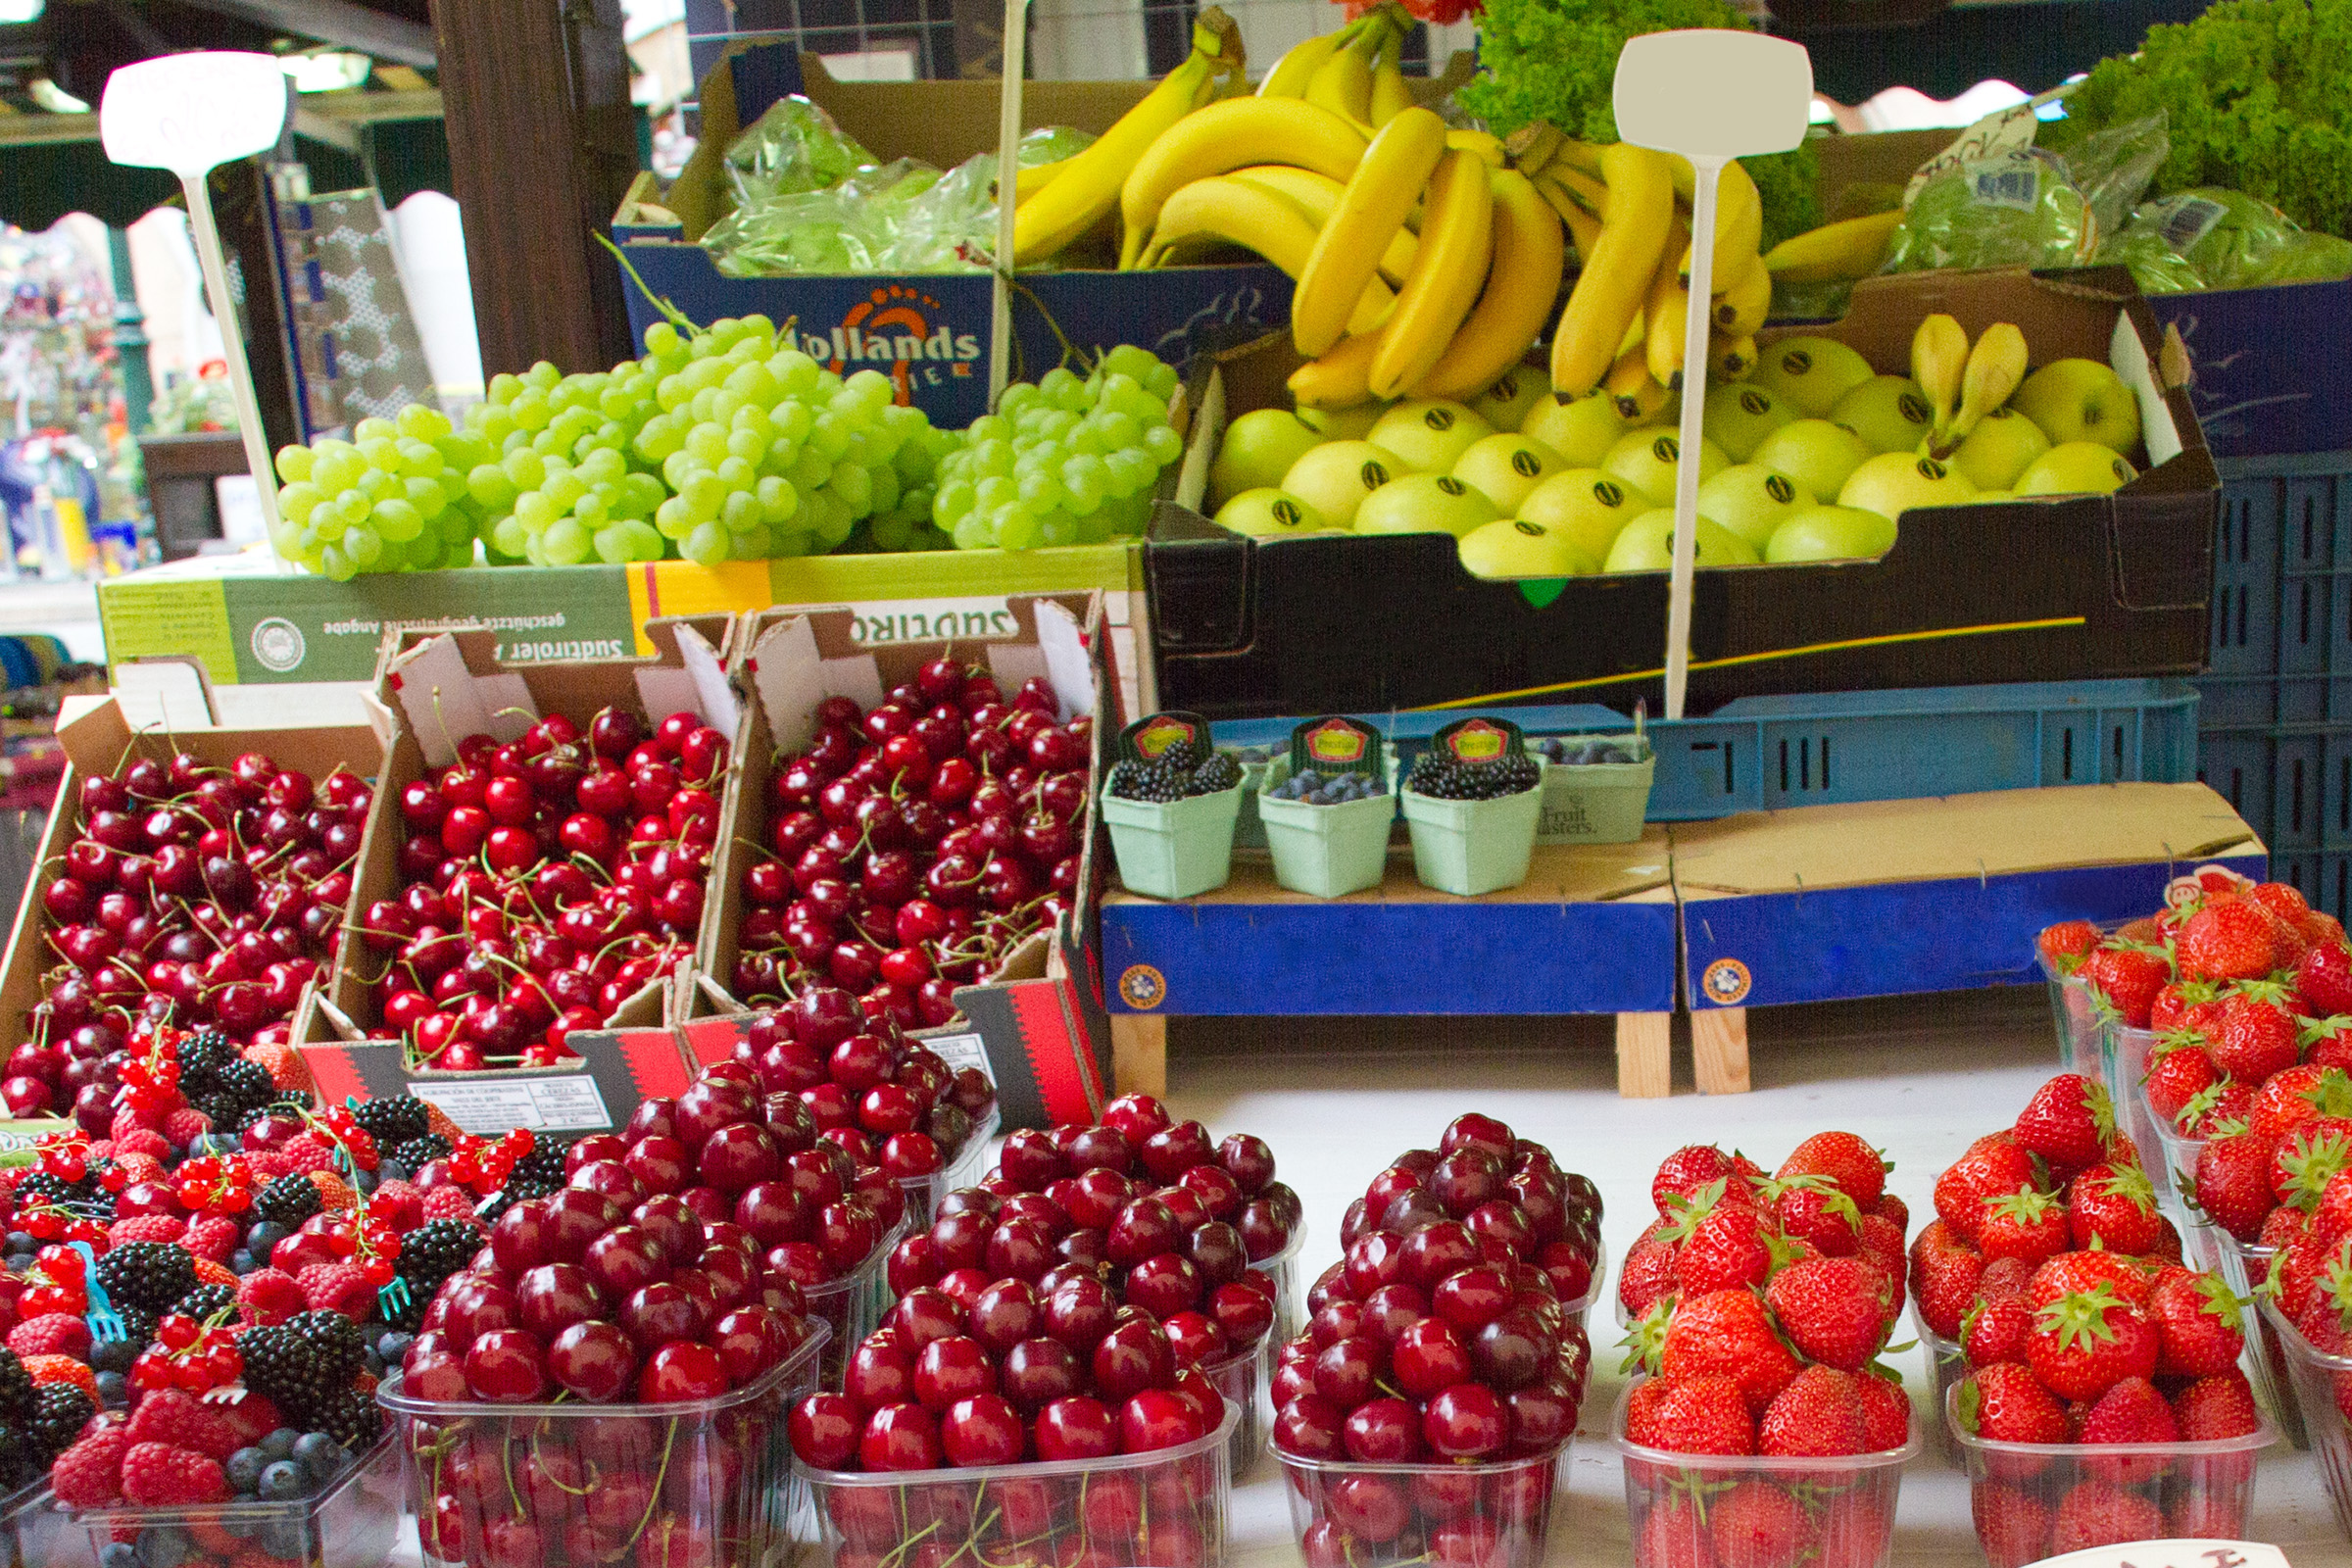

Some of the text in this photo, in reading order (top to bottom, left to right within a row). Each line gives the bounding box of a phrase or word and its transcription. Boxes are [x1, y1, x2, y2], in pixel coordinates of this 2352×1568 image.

[322, 618, 379, 635] Angabe
[484, 612, 565, 632] geschützte
[1542, 806, 1586, 822] Fruit
[1537, 821, 1597, 835] asters.
